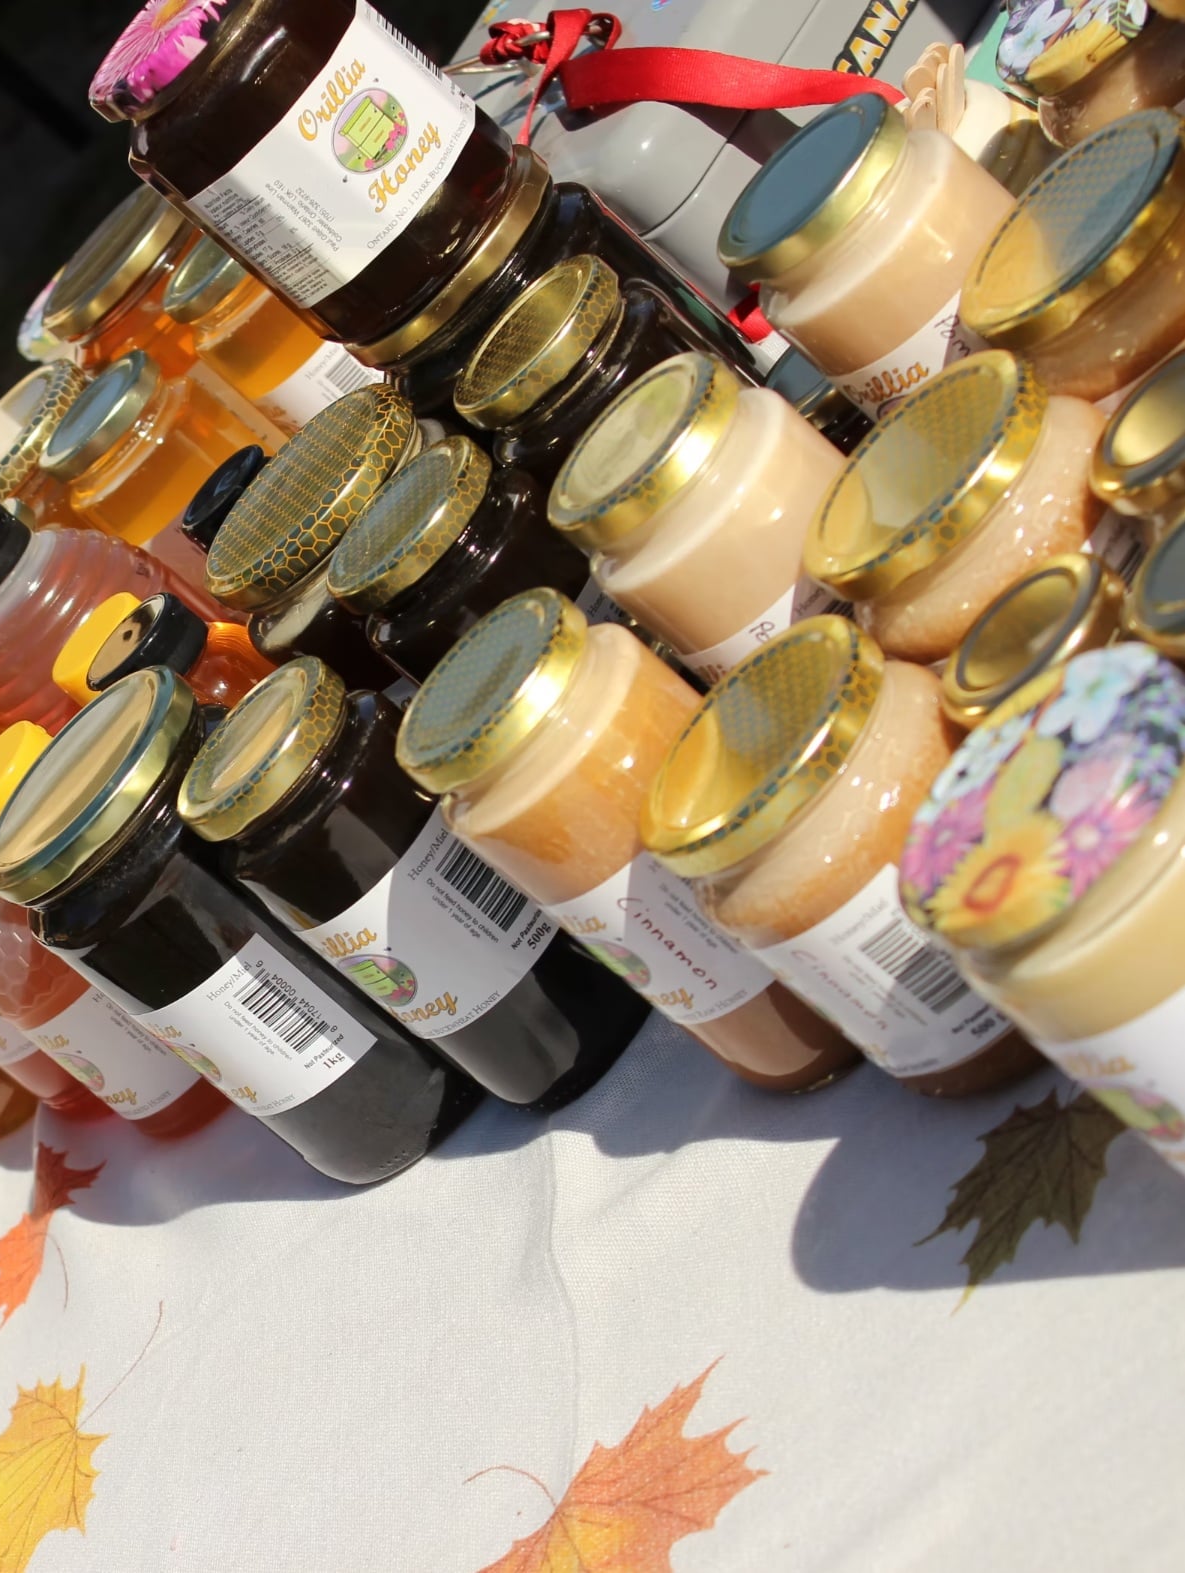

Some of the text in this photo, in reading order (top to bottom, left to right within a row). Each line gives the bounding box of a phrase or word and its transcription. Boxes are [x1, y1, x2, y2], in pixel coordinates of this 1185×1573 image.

[297, 58, 366, 142] Orillia
[367, 121, 442, 213] Honey
[365, 215, 399, 252] ONTARIO
[411, 178, 431, 200] DARK
[425, 877, 500, 943] Do not feed honey to children
[430, 893, 449, 910] under
[449, 910, 466, 926] year
[462, 920, 472, 930] of
[509, 936, 523, 950] Not
[525, 920, 552, 950] 500g
[616, 897, 718, 990] Cinnamon
[206, 961, 252, 1002] Honey/Miel
[270, 973, 297, 997] 00004
[297, 996, 324, 1021] 17044
[471, 990, 502, 1014] HONEY
[222, 1000, 295, 1061] Do not feed honey to children
[227, 1013, 245, 1029] under
[245, 1029, 260, 1043] year
[258, 1038, 267, 1047] of
[304, 1058, 315, 1070] Not
[323, 1052, 346, 1070] 1kg
